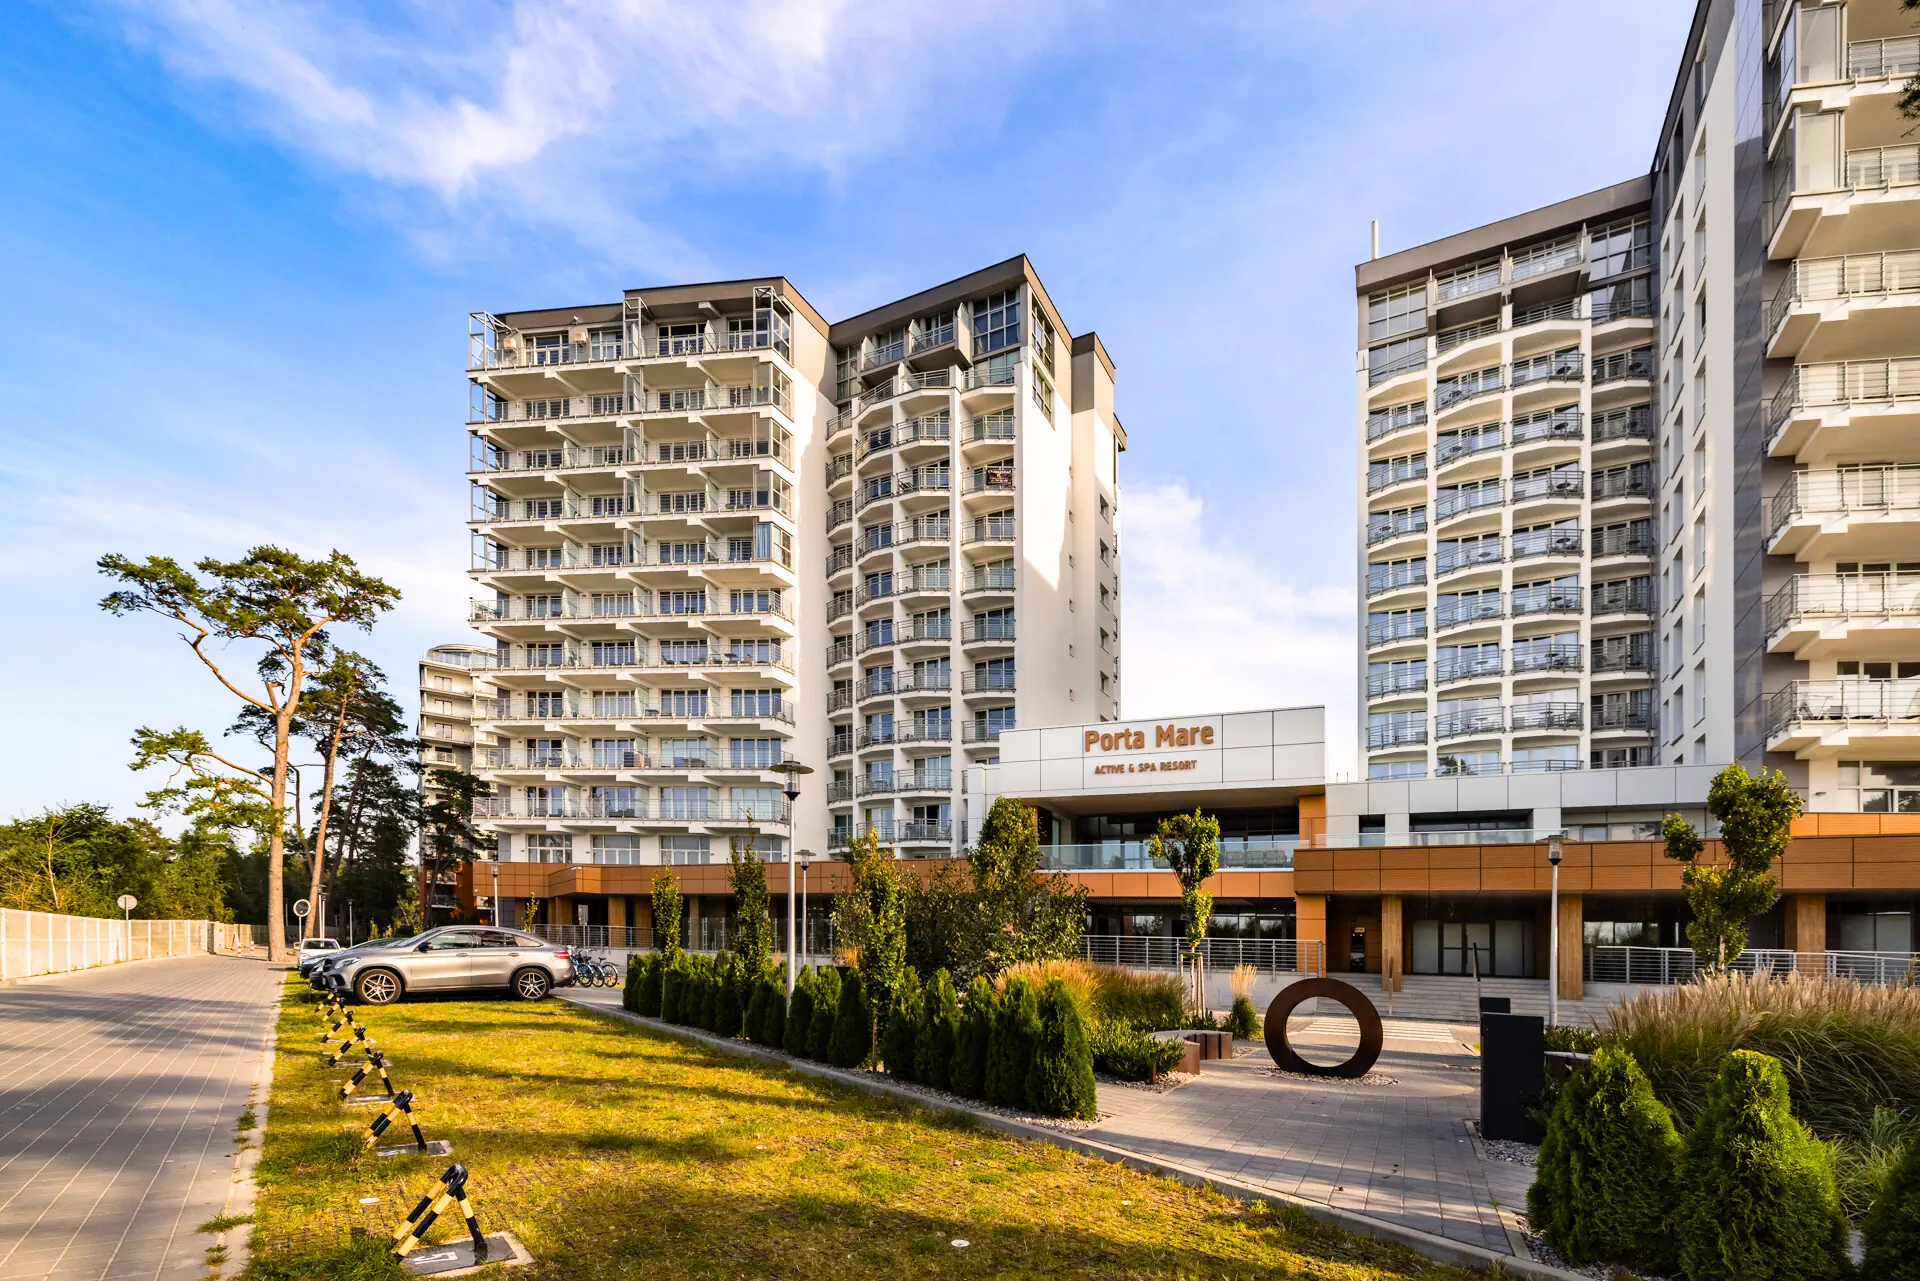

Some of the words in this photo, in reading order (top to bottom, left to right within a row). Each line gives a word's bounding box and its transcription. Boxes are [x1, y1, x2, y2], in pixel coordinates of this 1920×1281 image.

[1084, 727, 1145, 752] Porta
[1155, 724, 1214, 748] Mare
[1094, 763, 1125, 775] ACTIVE
[1128, 763, 1135, 773] &
[1138, 762, 1157, 773] SPA
[1159, 759, 1198, 772] RESORT
